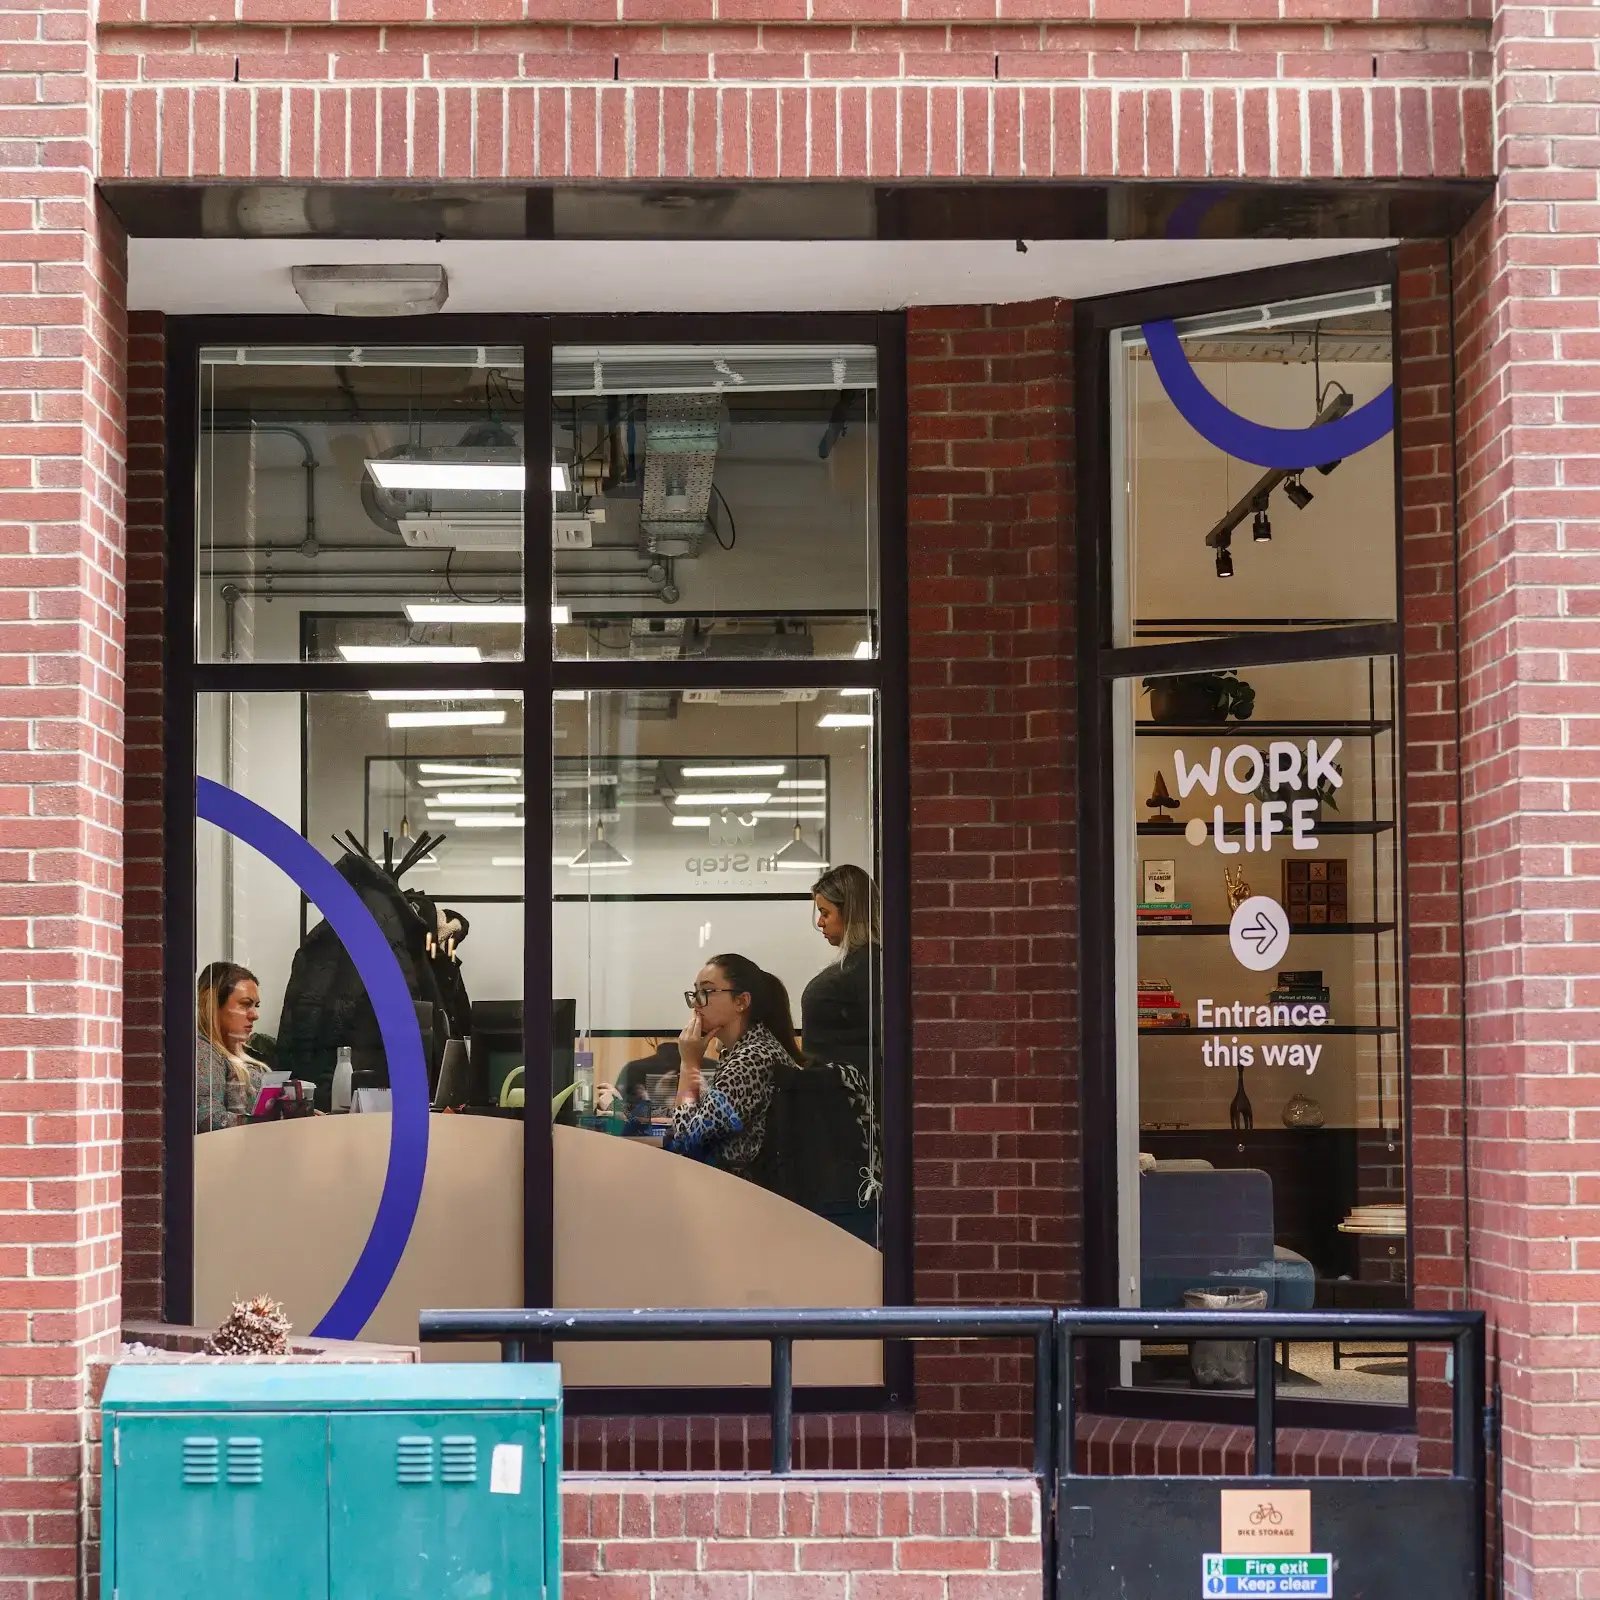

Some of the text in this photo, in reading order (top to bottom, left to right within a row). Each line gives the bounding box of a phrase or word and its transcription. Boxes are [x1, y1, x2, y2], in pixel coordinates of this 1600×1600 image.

[1173, 738, 1343, 798] WORK
[1197, 998, 1327, 1028] Entrance
[1201, 1035, 1323, 1076] this way
[1237, 1529, 1294, 1537] BIKE STORAGE
[1245, 1559, 1309, 1575] Fire exit
[1237, 1577, 1318, 1593] Keep clear
